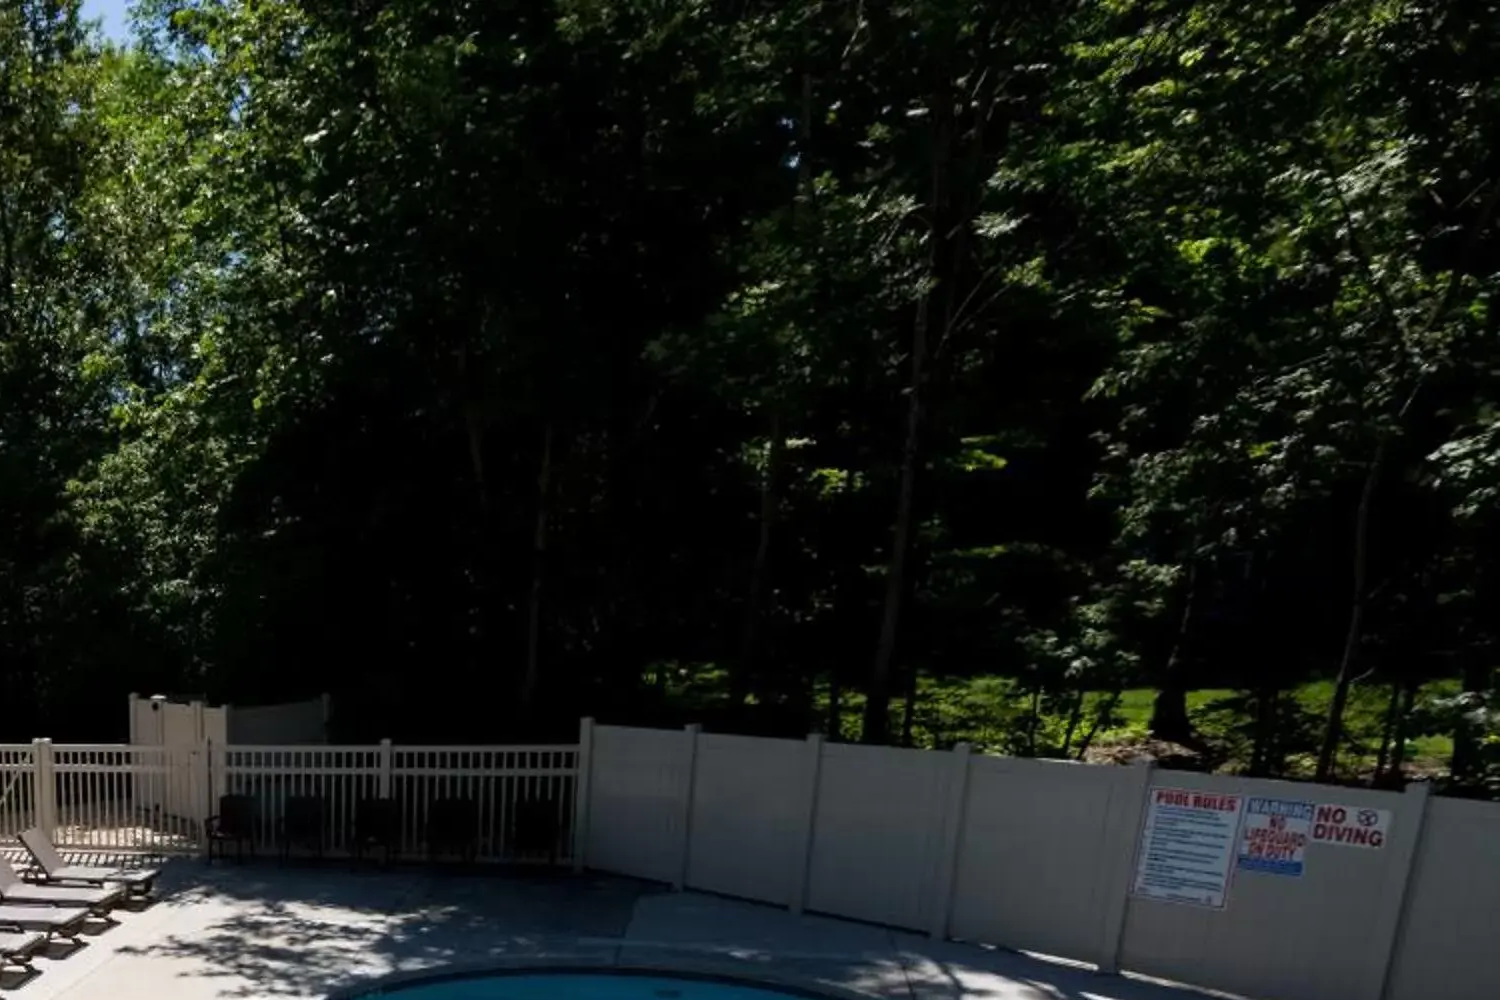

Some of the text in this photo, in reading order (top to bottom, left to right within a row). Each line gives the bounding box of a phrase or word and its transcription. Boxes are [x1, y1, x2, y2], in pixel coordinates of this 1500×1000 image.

[1156, 790, 1237, 812] POOL RULES
[1251, 799, 1312, 820] WARNING
[1270, 815, 1287, 831] NO
[1316, 806, 1347, 824] NO
[1244, 827, 1306, 848] LIFEGUARD
[1313, 823, 1383, 848] DIVING
[1249, 842, 1297, 861] ON DUTY
